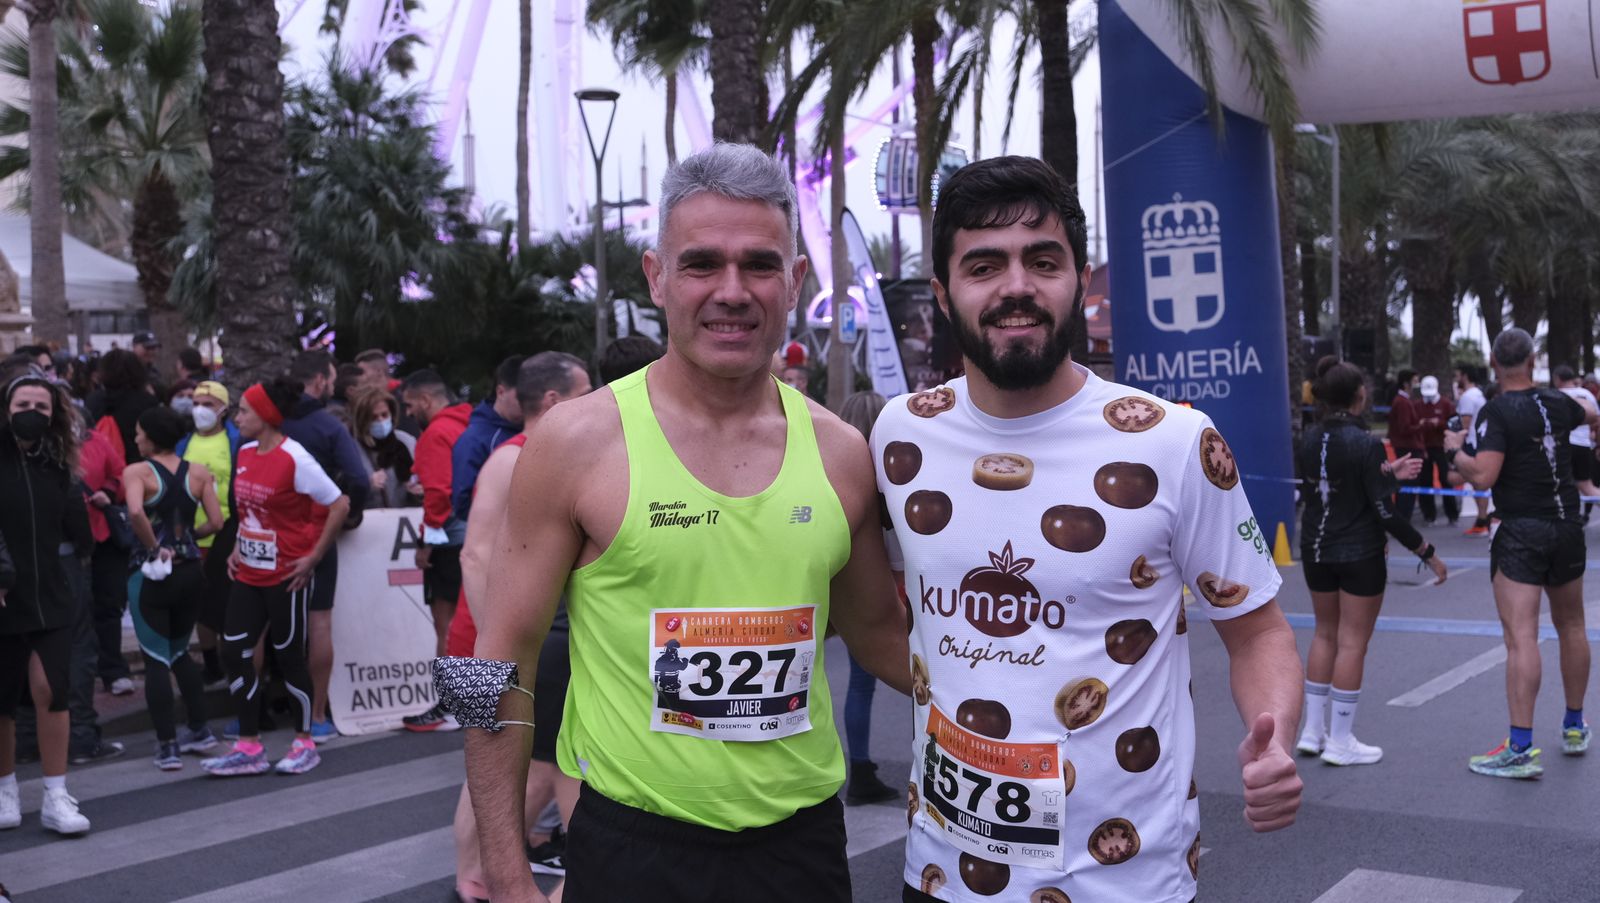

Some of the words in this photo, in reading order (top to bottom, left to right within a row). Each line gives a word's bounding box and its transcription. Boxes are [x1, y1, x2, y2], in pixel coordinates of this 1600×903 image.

[843, 307, 853, 329] P
[1125, 340, 1263, 382] ALMERÍA
[1152, 380, 1231, 400] CIUDAD
[648, 501, 687, 512] Maratón
[690, 616, 730, 626] CARRERA
[738, 615, 785, 625] BOMBEROS
[742, 626, 776, 636] CIUDAD
[938, 634, 1046, 669] Original
[688, 648, 796, 697] 327
[726, 700, 761, 716] JAVIER
[759, 720, 779, 731] CASI
[971, 739, 1016, 757] BOMBEROS
[973, 750, 1006, 766] CIUDAD
[938, 753, 1031, 824] 578
[957, 810, 992, 837] KUMATO
[952, 829, 980, 846] COSENTINO
[987, 843, 1009, 855] CASI
[1021, 846, 1055, 859] formas
